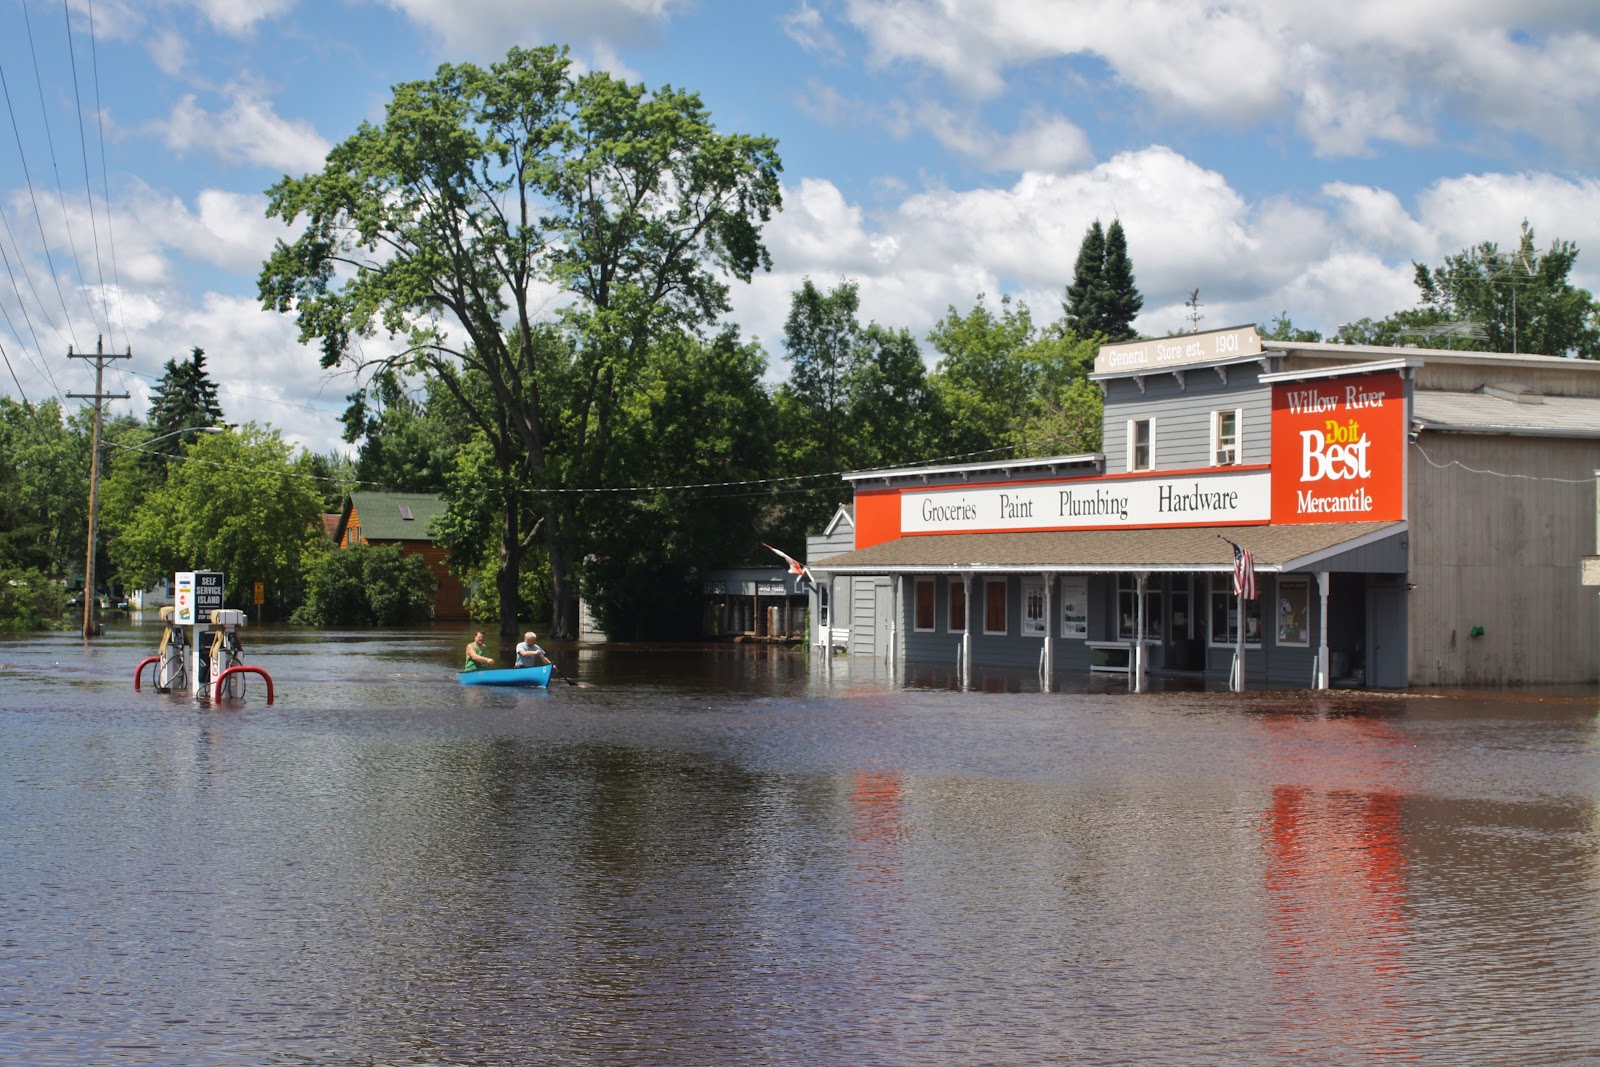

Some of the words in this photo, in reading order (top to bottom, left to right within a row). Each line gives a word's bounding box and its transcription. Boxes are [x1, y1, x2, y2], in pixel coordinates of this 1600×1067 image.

[1109, 347, 1148, 367] General
[1157, 344, 1182, 362] Store
[1186, 341, 1205, 358] est.
[1215, 333, 1239, 353] 1901
[1287, 389, 1338, 415] Willow
[1345, 386, 1385, 410] River
[1299, 430, 1371, 482] Best
[922, 498, 976, 522] Groceries
[1000, 494, 1033, 519] Paint
[1059, 489, 1128, 520] Plumbing
[1158, 482, 1238, 513] Hardware
[1297, 487, 1372, 514] Mercantile
[196, 586, 221, 595] SERVICE
[202, 577, 216, 585] SELF
[198, 596, 220, 604] ISLAND
